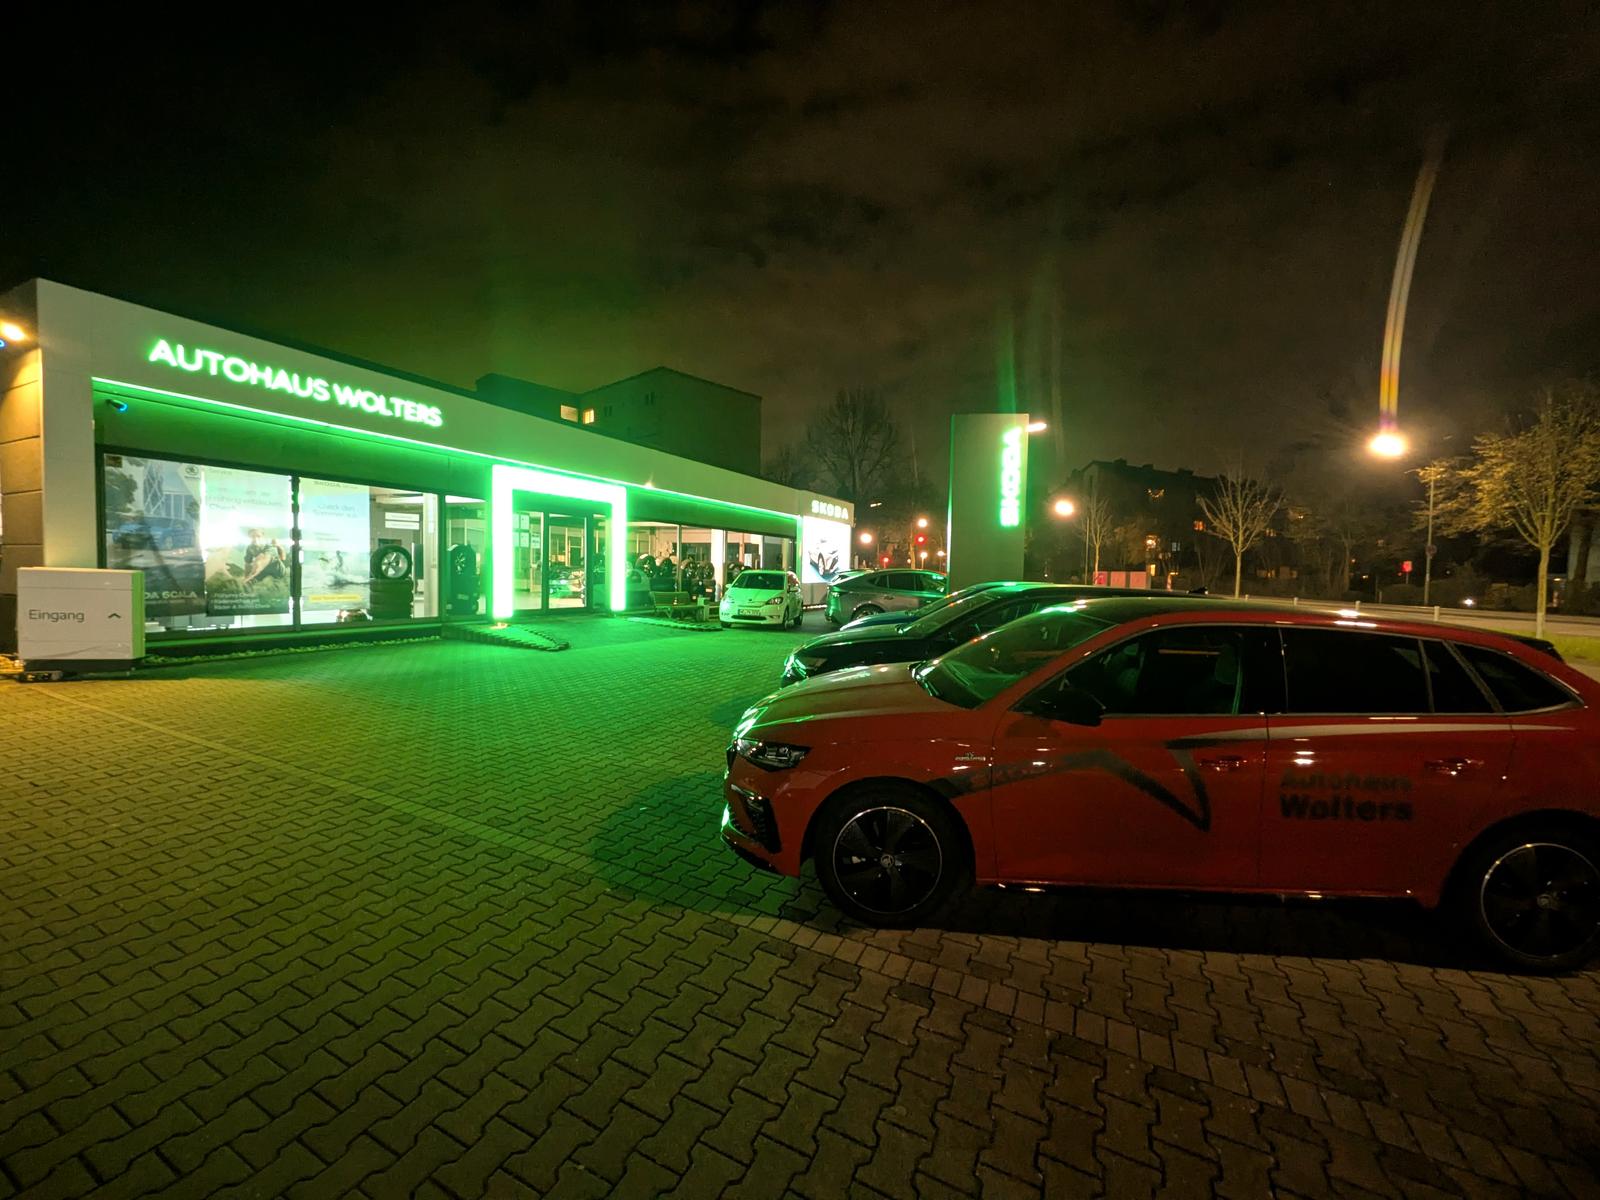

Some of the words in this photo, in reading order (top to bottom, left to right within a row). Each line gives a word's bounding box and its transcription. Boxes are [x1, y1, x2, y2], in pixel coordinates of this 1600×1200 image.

[148, 338, 331, 402] AUTOHAUS
[332, 383, 443, 428] WOLTERS
[28, 609, 86, 623] Eingang
[1280, 794, 1413, 820] Wolters
